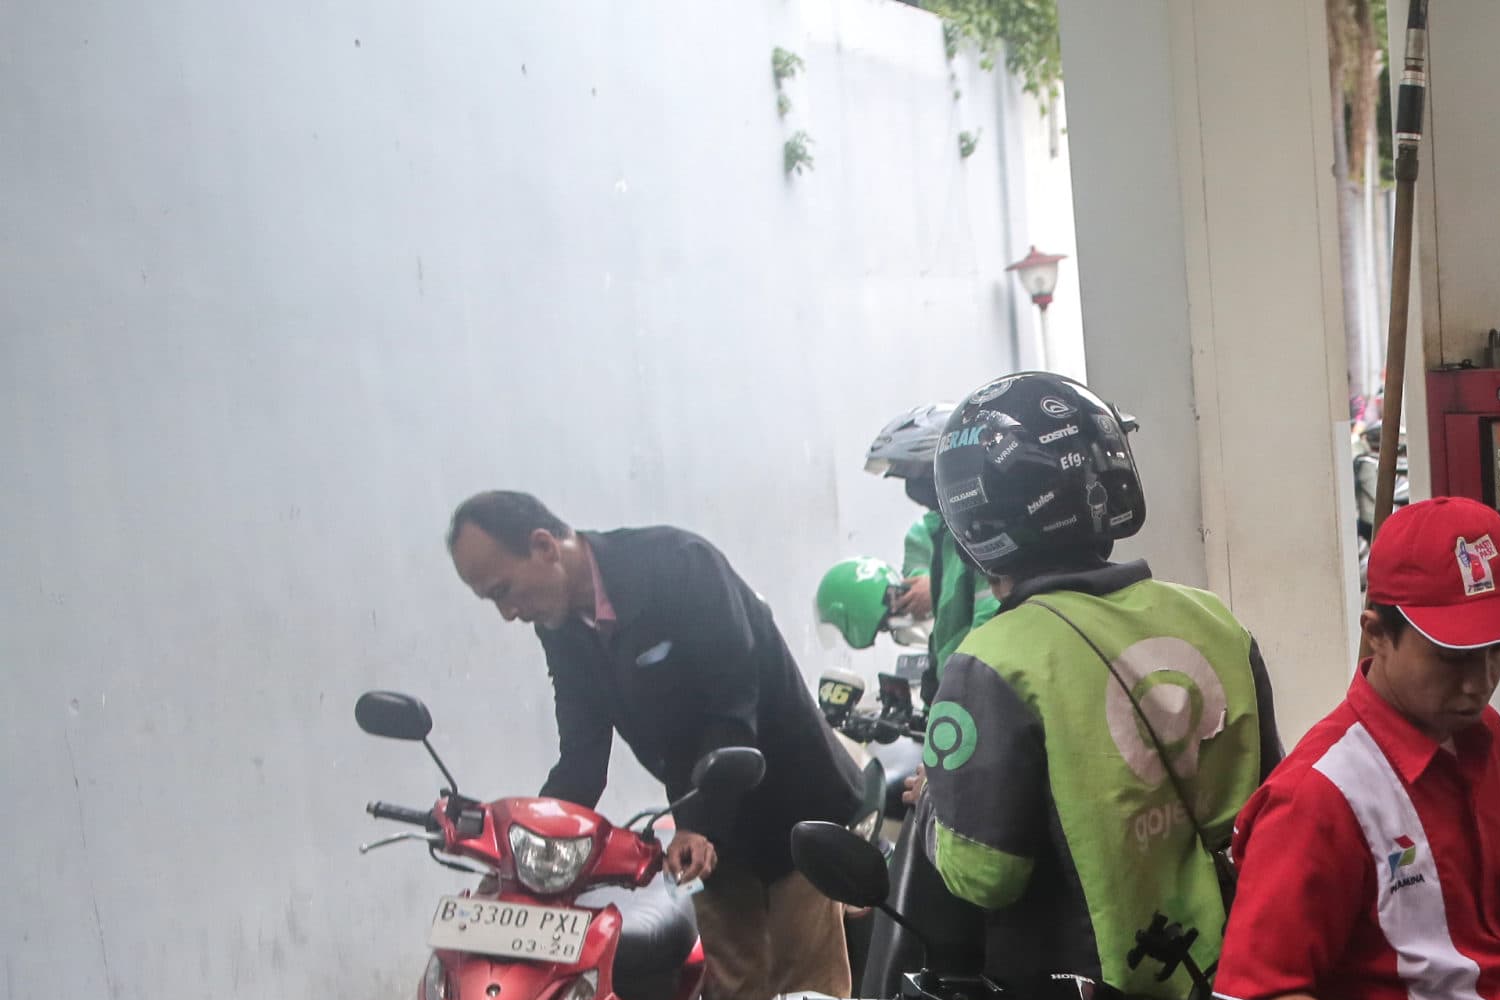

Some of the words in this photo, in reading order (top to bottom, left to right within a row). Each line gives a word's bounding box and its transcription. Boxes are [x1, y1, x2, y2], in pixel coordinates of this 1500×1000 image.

[441, 901, 457, 922] B
[470, 903, 528, 928] 3300
[539, 911, 581, 935] PXL
